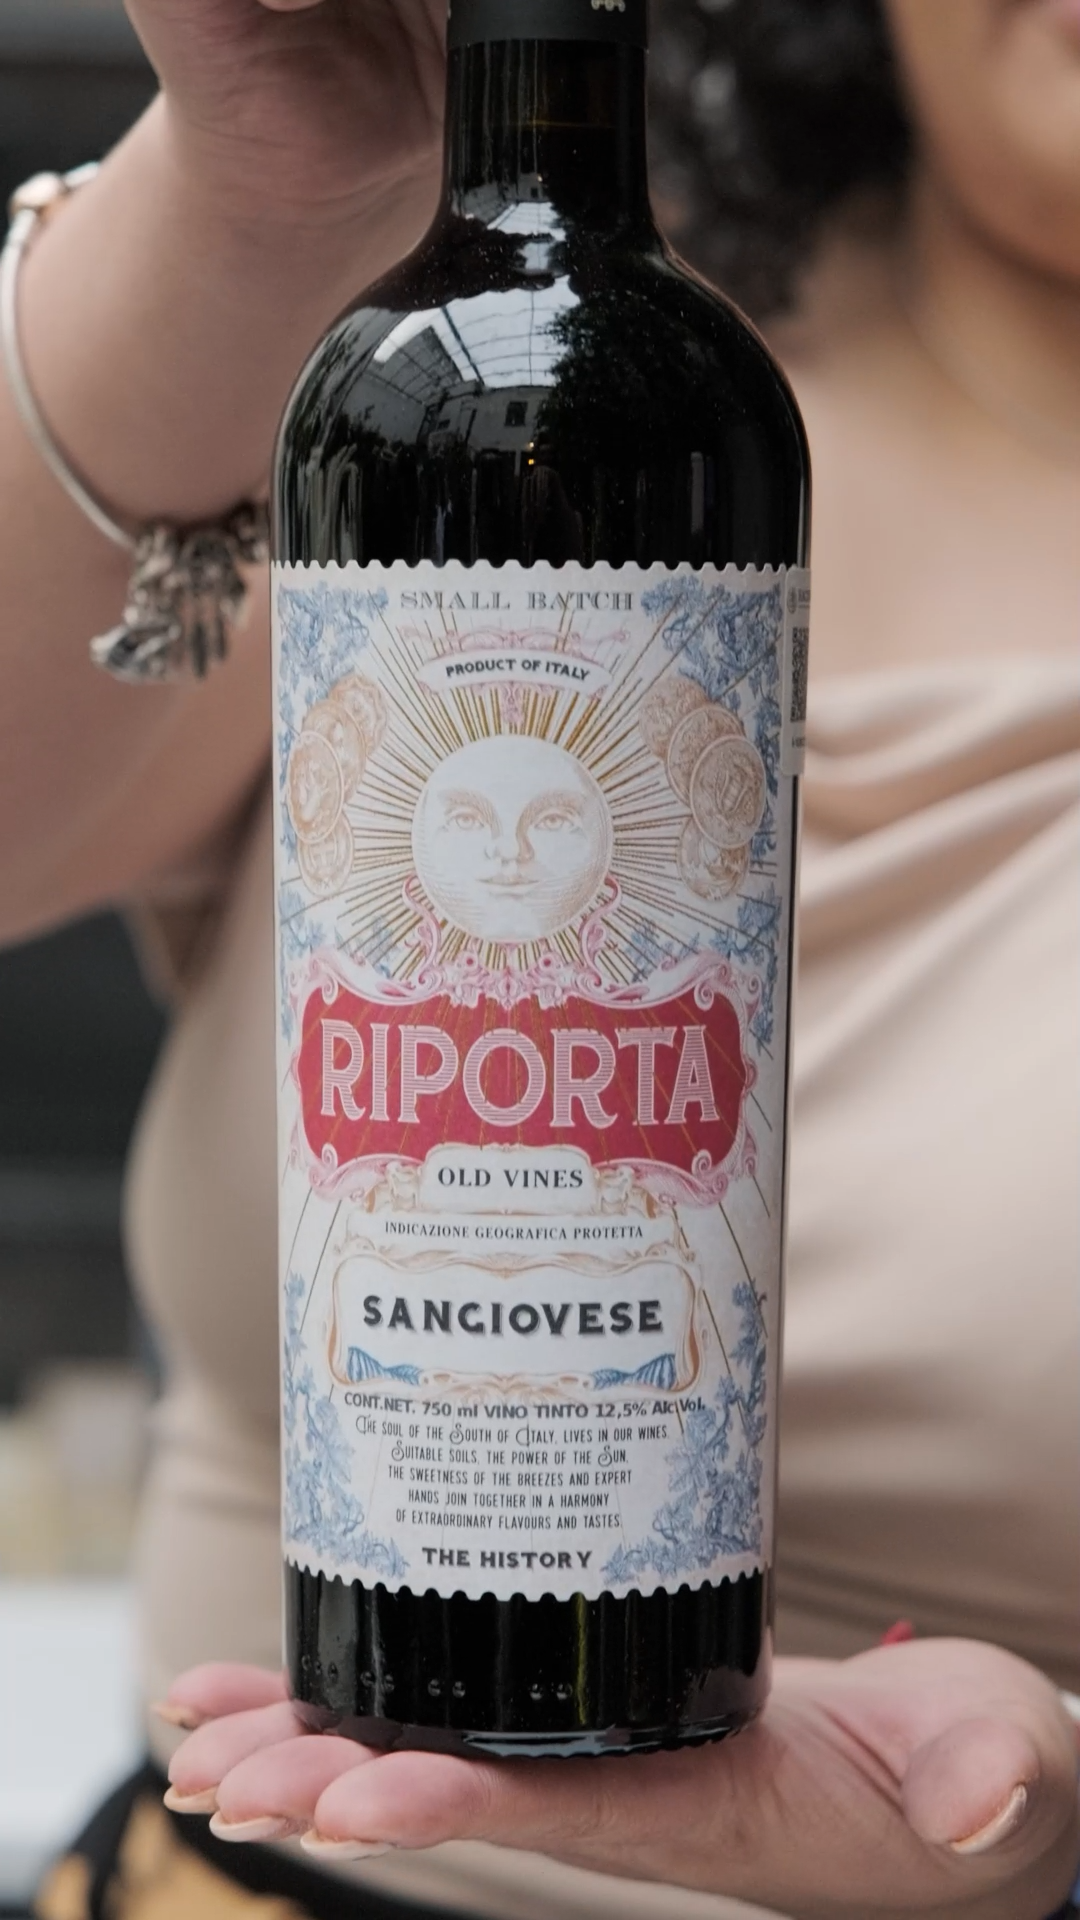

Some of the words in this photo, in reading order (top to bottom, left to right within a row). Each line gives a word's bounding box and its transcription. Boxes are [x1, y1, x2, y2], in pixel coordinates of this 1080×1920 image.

[400, 590, 510, 611] SMALL
[527, 590, 634, 611] BATCH
[445, 658, 517, 678] PRODUCT
[521, 659, 542, 672] OF
[545, 661, 590, 681] ITALY
[320, 1017, 721, 1129] RIPORTA
[437, 1166, 491, 1188] OLD
[503, 1168, 584, 1188] VINES
[385, 1221, 470, 1239] INDICAZIONE
[475, 1227, 568, 1240] GEOGRAFICA
[573, 1225, 644, 1239] PROTETTA
[363, 1295, 663, 1337] SANGIOVESE
[422, 1401, 452, 1417] 750
[457, 1404, 478, 1418] ml
[484, 1404, 528, 1419] VINO
[533, 1403, 589, 1419] TINTO
[595, 1402, 647, 1420] 12,5%
[382, 1420, 404, 1438] SOUL
[408, 1424, 421, 1439] OF
[426, 1425, 444, 1441] THE
[497, 1428, 509, 1443] OF
[564, 1428, 593, 1444] LIVES
[598, 1427, 608, 1443] IN
[613, 1427, 633, 1442] OUR
[487, 1450, 506, 1465] THE
[511, 1450, 548, 1465] POWER
[554, 1450, 567, 1465] OF
[573, 1450, 592, 1465] THE
[388, 1464, 405, 1481] THE
[410, 1466, 468, 1486] SWEETNESS
[473, 1471, 486, 1486] OF
[492, 1471, 511, 1487] THE
[517, 1471, 564, 1487] BREEZES
[569, 1471, 590, 1487] AND
[595, 1469, 632, 1487] EXPERT
[408, 1488, 440, 1505] HANDS
[445, 1491, 468, 1507] JOIN
[473, 1492, 526, 1508] TOGETHER
[532, 1493, 542, 1508] IN
[548, 1493, 555, 1508] A
[560, 1492, 610, 1508] HARMONY
[396, 1507, 407, 1523] OF
[412, 1509, 493, 1529] EXTRAORDINARY
[498, 1514, 551, 1530] FLAVOURS
[556, 1514, 578, 1530] AND
[421, 1546, 471, 1567] THE
[480, 1550, 593, 1569] HISTORY
